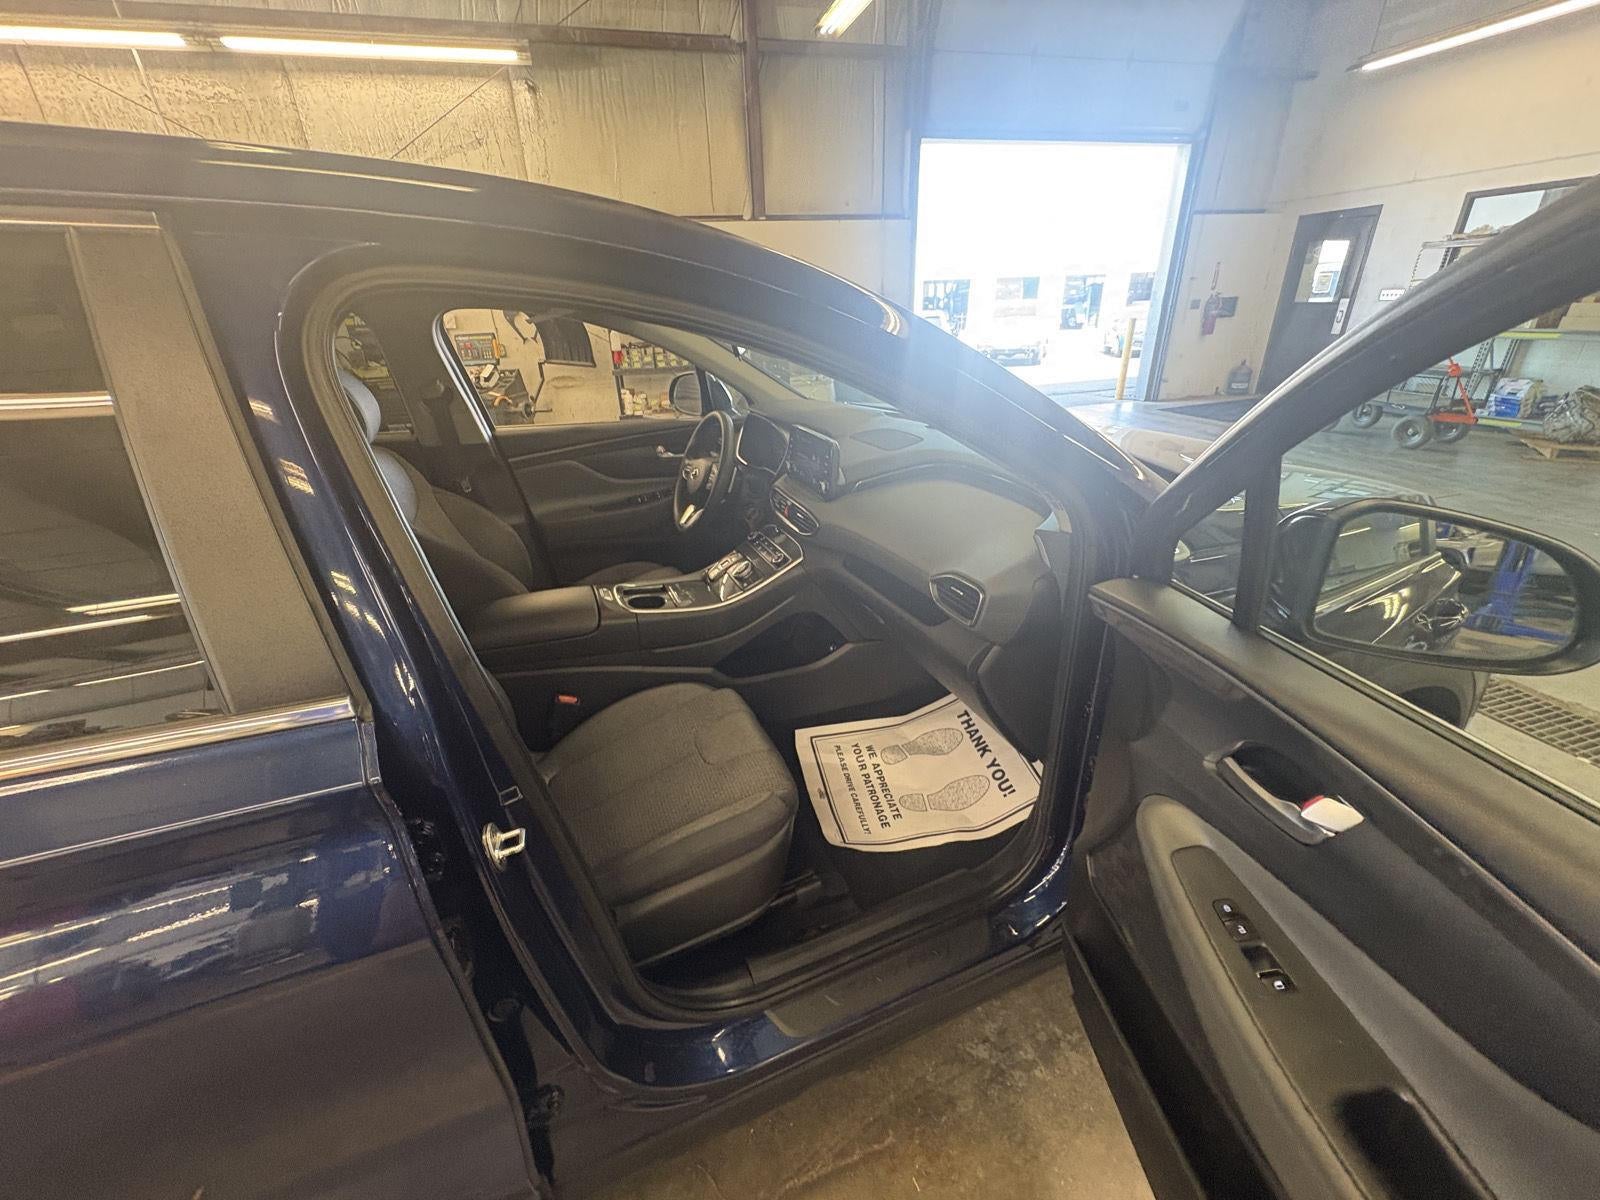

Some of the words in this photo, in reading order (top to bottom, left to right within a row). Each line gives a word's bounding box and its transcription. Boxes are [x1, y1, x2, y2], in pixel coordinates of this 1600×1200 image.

[833, 744, 849, 772] PLEASE
[843, 772, 856, 792] DRIVE
[851, 742, 868, 772] YOUR
[861, 772, 891, 829] PATRONAGE
[865, 744, 878, 760] WE
[872, 762, 903, 821] APPRECIATE
[957, 709, 992, 759] THANK
[986, 757, 1016, 798] YOU!
